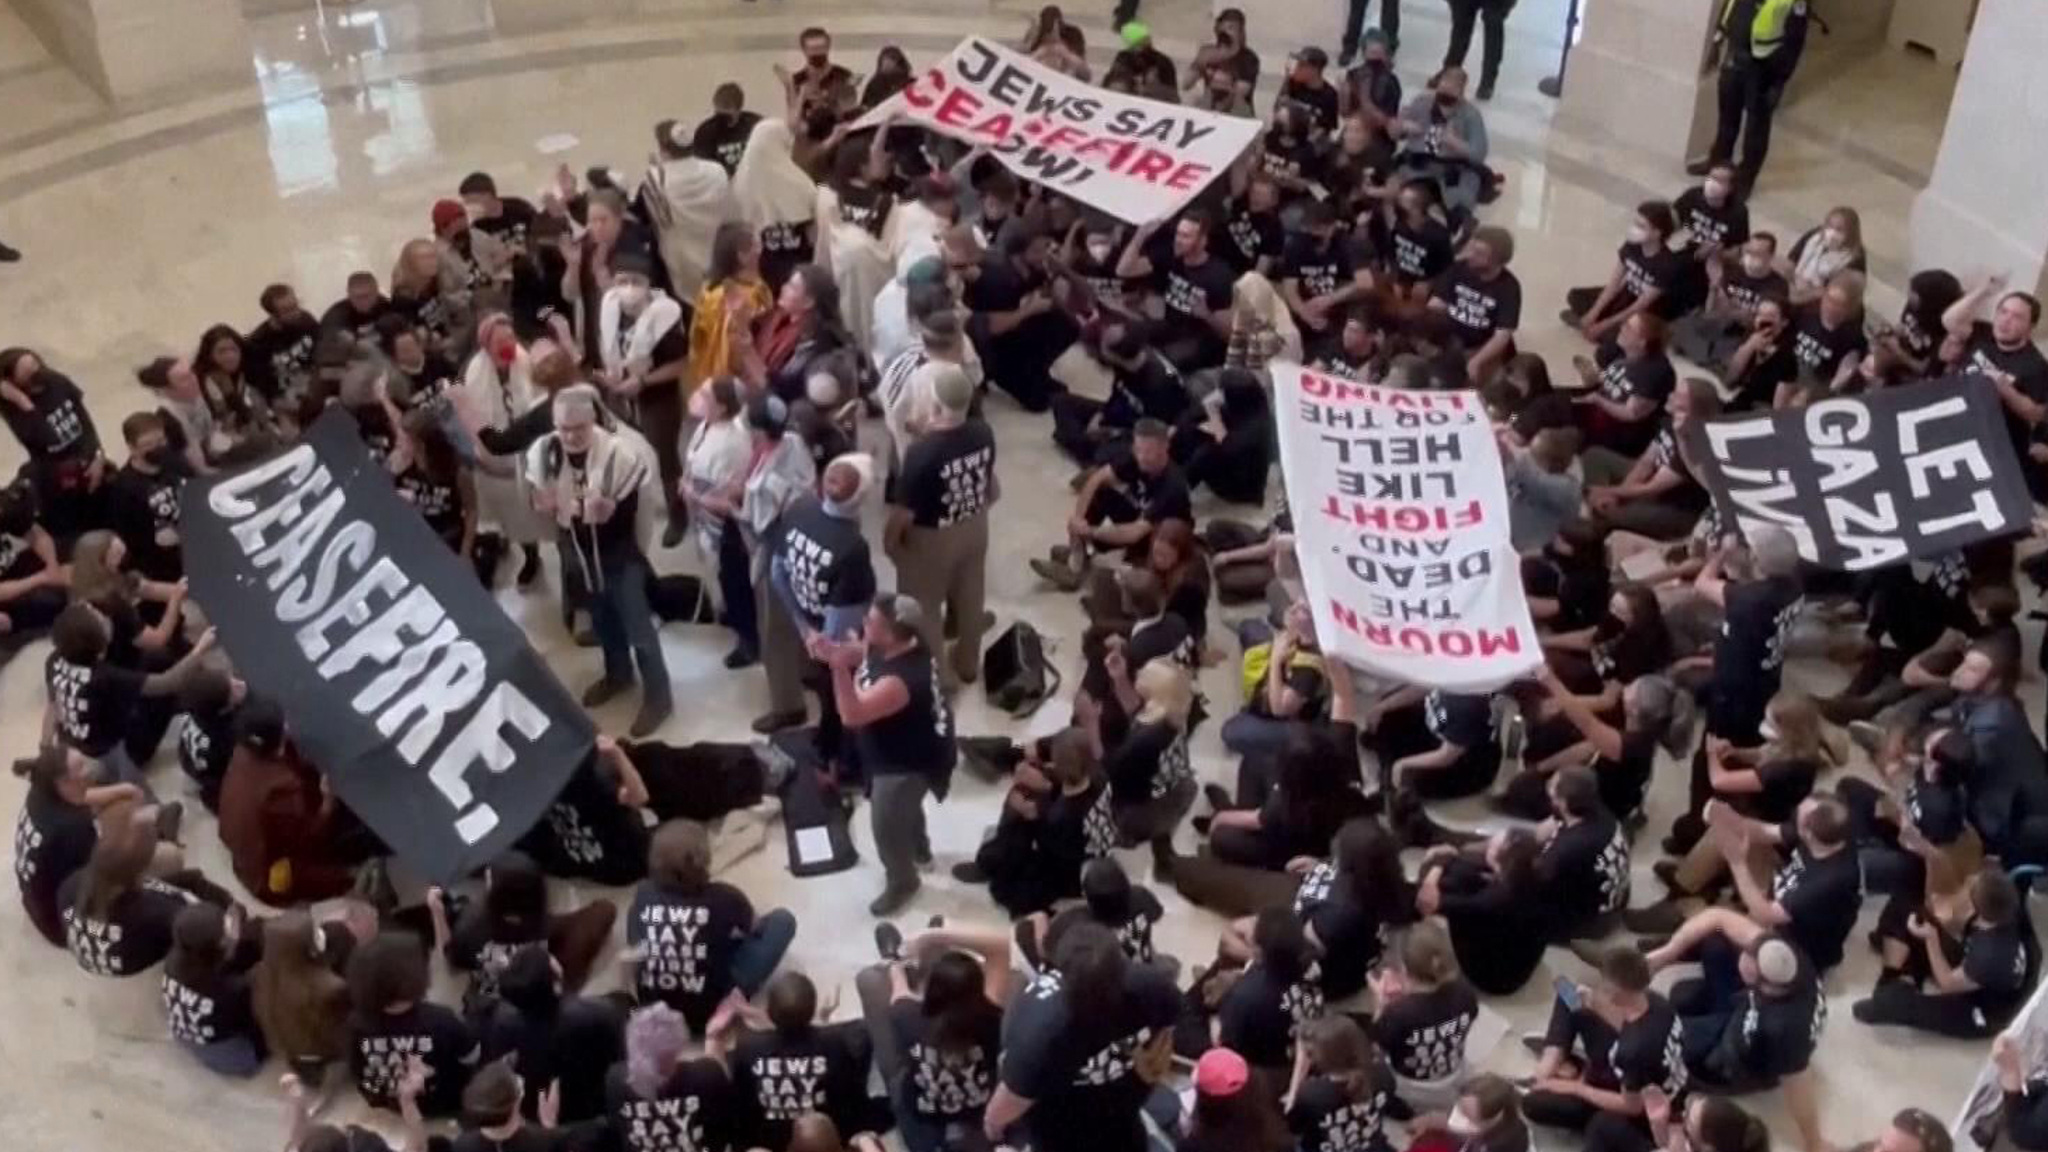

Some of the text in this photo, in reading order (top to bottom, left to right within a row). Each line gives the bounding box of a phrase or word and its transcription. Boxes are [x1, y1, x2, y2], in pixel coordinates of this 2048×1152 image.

[957, 40, 1215, 149] JEWS SAY
[994, 133, 1094, 186] OW!
[1301, 373, 1464, 410] LIVING
[1300, 399, 1382, 430] THE
[1321, 432, 1462, 465] HELL
[1897, 397, 2006, 535] LET
[1336, 469, 1457, 500] LIKE
[1805, 398, 1908, 571] GAZA
[1322, 496, 1483, 532] FIGHT
[1359, 533, 1450, 557] AND
[1371, 594, 1461, 622] THE
[1331, 599, 1521, 658] MOURN
[208, 444, 551, 845] CEASEFIRE.
[640, 904, 709, 925] JEWS
[647, 924, 698, 944] SAY
[752, 1055, 828, 1076] JEWS
[761, 1077, 817, 1096] SAY
[620, 1095, 700, 1118] JEWS
[632, 1112, 692, 1138] SAY
